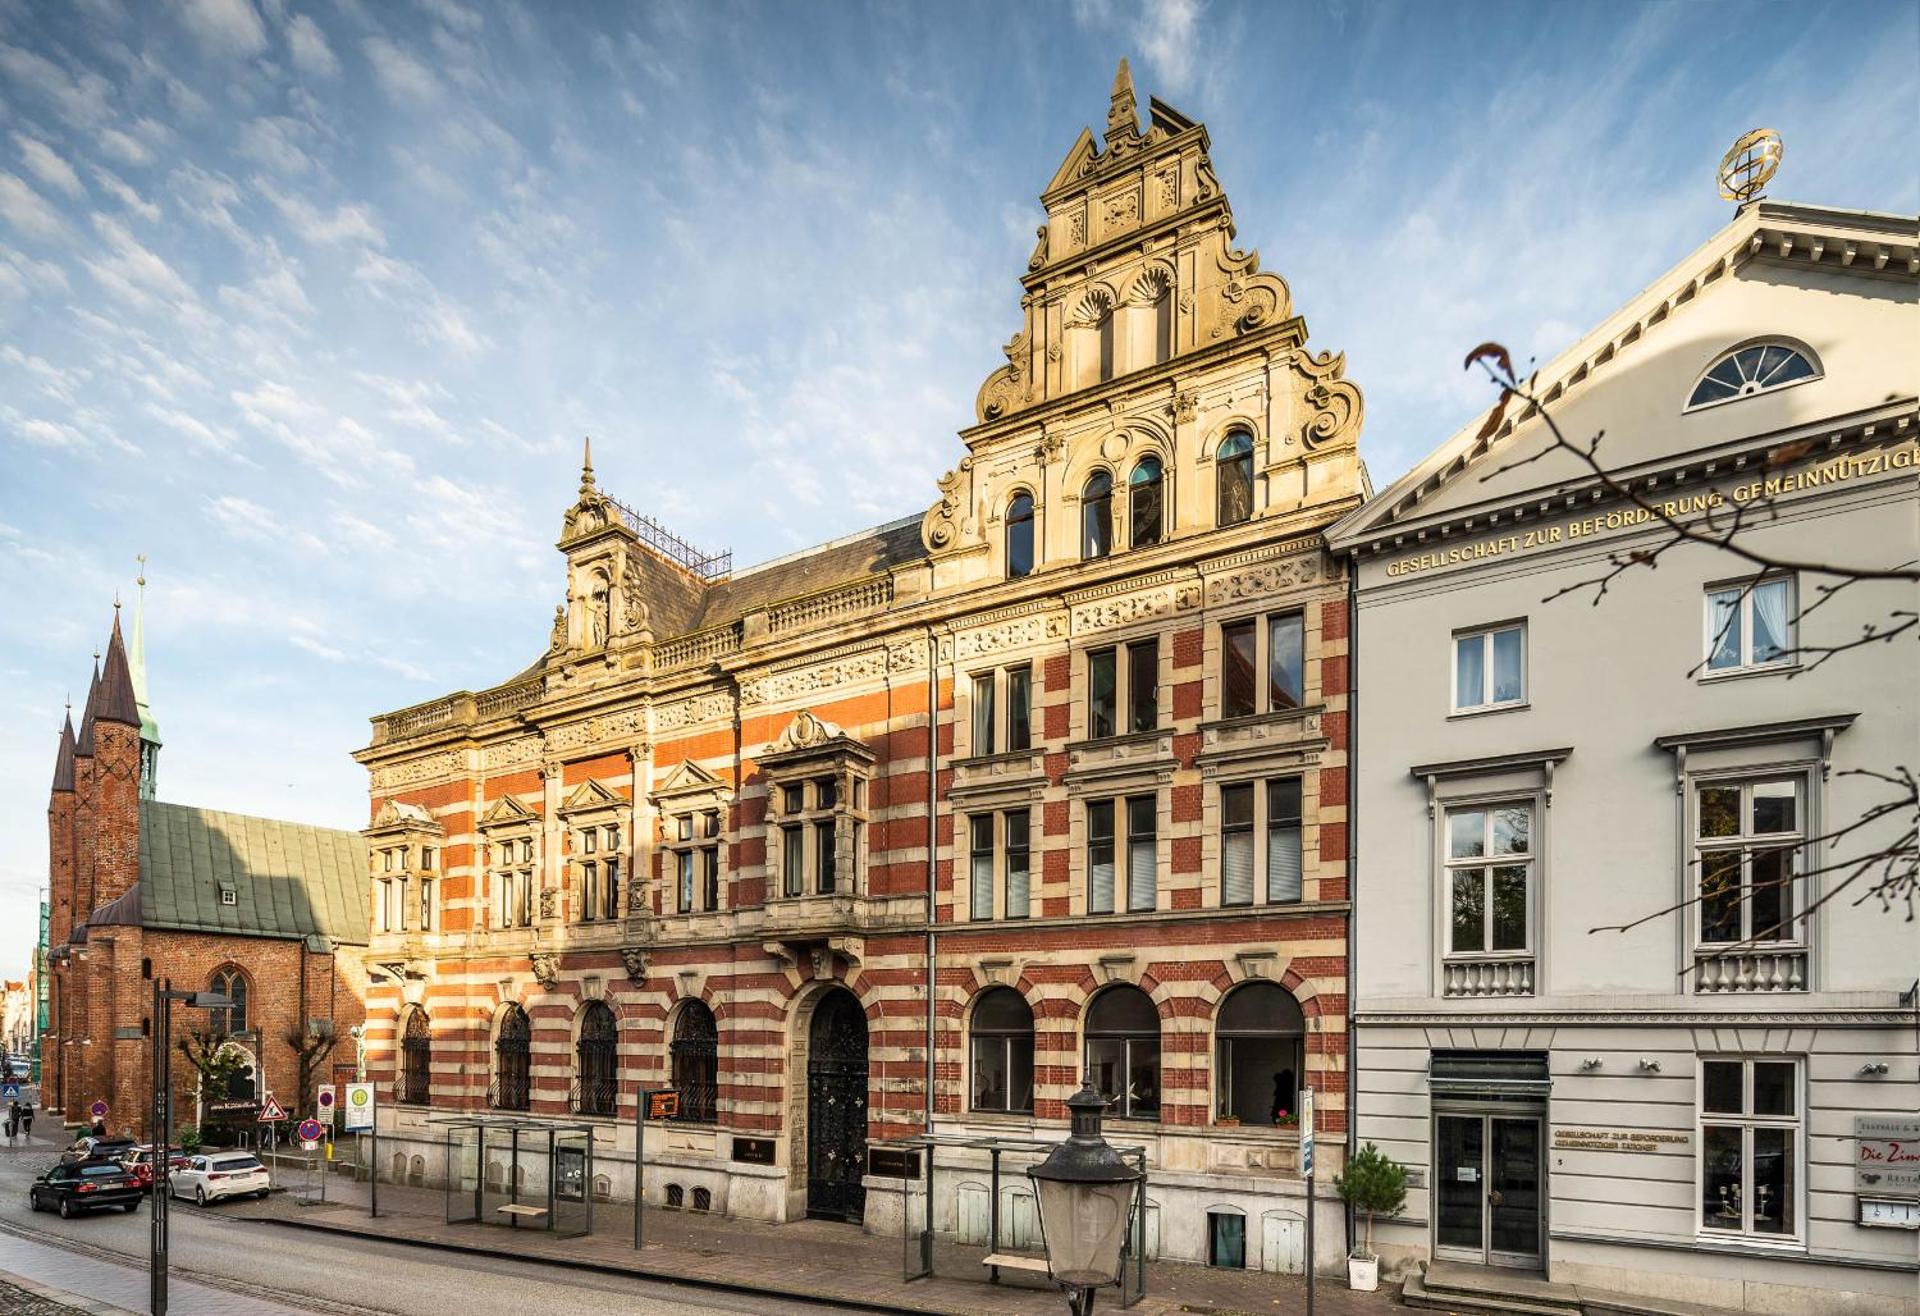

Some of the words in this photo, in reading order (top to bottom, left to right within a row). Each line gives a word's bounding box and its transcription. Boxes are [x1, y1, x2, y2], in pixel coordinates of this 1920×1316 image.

[1386, 536, 1518, 577] GESELLSCHAFT
[1523, 526, 1562, 549] ZUR
[1568, 492, 1724, 540] BEFÖRDERUNG
[1861, 1146, 1884, 1161] Die
[1887, 1142, 1920, 1162] Zim
